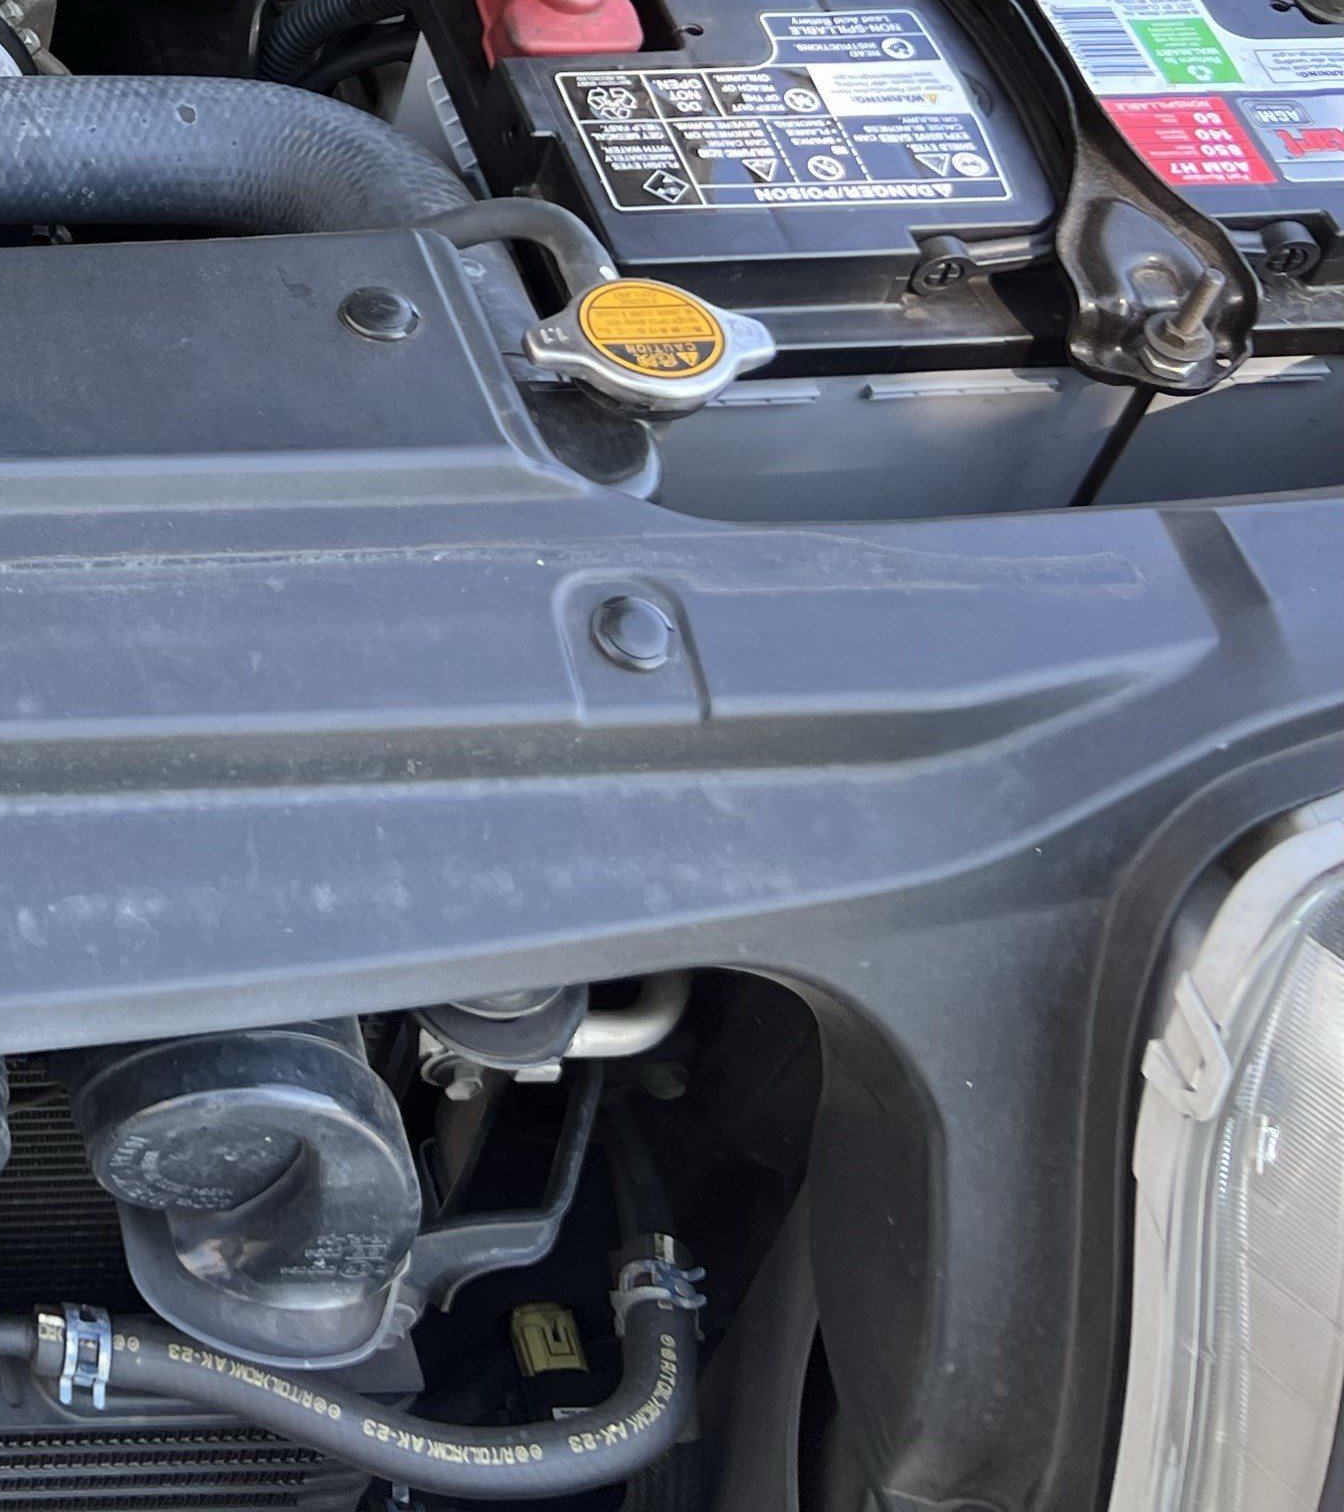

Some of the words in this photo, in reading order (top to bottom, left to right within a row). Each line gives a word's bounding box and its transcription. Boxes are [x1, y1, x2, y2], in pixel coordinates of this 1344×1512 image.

[791, 16, 832, 26] Battery
[832, 16, 859, 25] Acid
[861, 15, 890, 25] Lead
[788, 23, 902, 36] NON-SPILLABLE
[793, 42, 877, 52] INSTRUCTIONS.
[1155, 47, 1220, 56] WALMART
[849, 49, 882, 57] READ
[652, 78, 701, 91] OPEN.
[721, 84, 736, 93] OF
[669, 90, 700, 101] NOT
[764, 93, 780, 102] OF
[676, 101, 702, 112] DO
[732, 103, 751, 112] OUT
[754, 103, 785, 112] KEEP
[1114, 98, 1210, 110] NONSPILLABLE
[1256, 109, 1300, 123] AGM
[644, 132, 665, 140] GET
[852, 133, 877, 143] CAN
[1194, 128, 1232, 141] 140
[744, 138, 768, 147] CAN
[645, 144, 672, 153] WITH
[1200, 144, 1243, 156] 850
[1169, 162, 1198, 174] H7
[1200, 161, 1250, 174] AGM
[754, 184, 936, 201] DANGER/POISON
[540, 327, 568, 344] 1.1
[625, 343, 696, 355] CAUTION
[168, 1342, 226, 1373] AK-23
[362, 1419, 425, 1452] AK-23
[569, 1422, 629, 1454] AK-23
